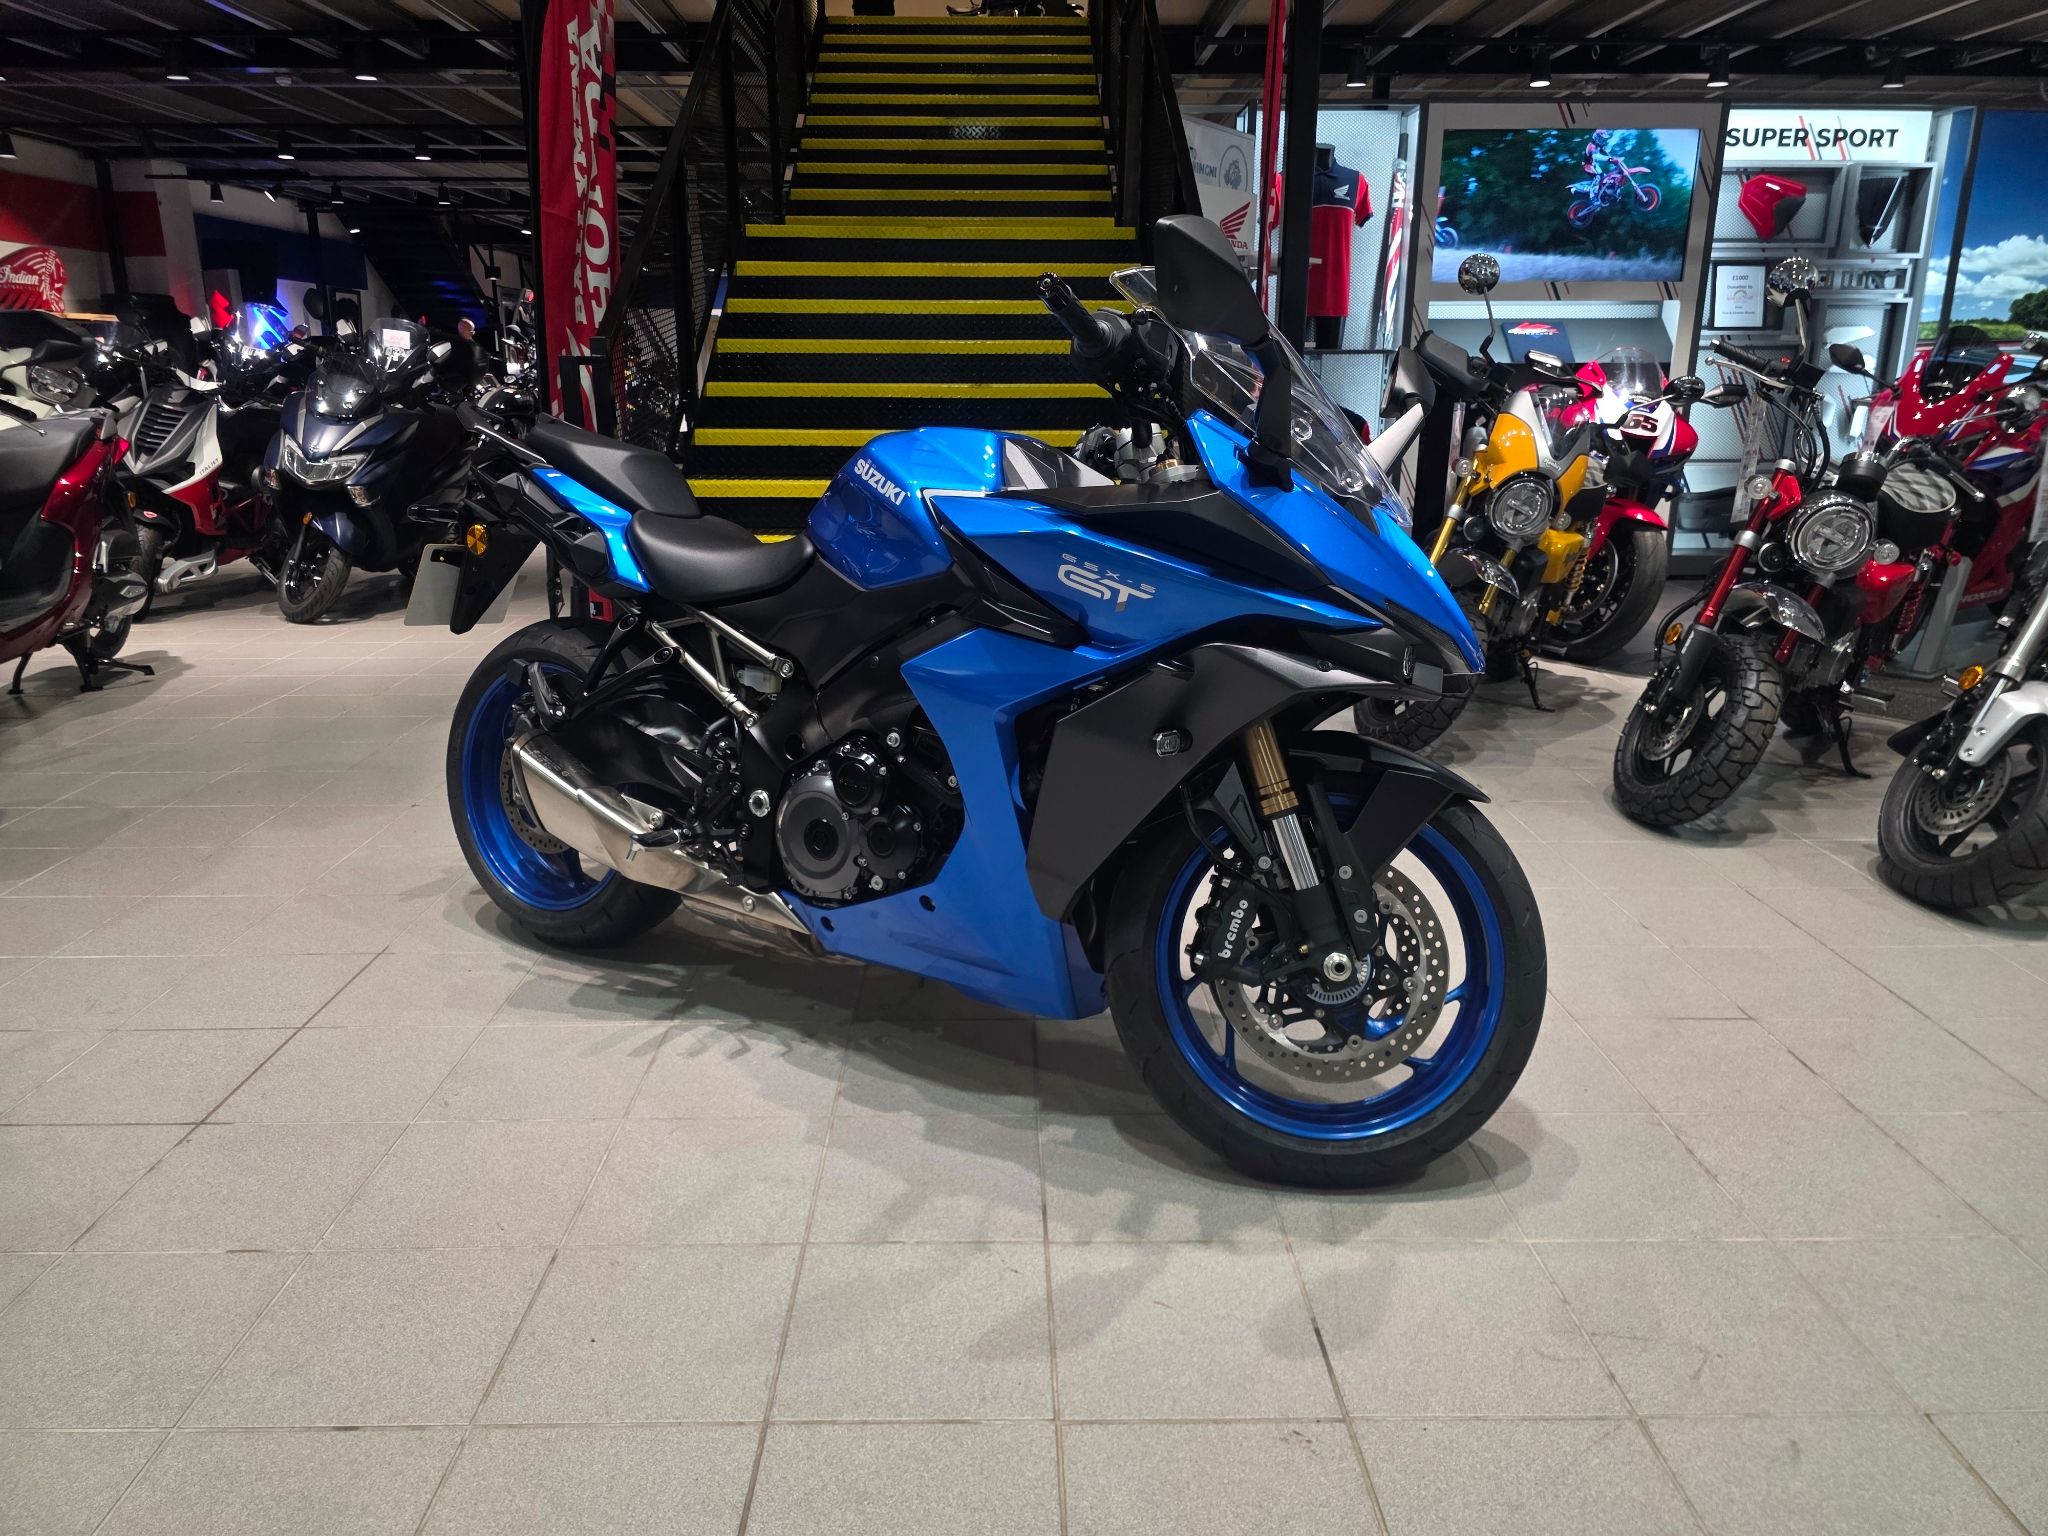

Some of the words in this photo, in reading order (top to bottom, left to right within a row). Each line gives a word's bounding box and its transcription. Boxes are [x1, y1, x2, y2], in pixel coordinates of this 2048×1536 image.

[1725, 127, 1809, 147] SUPER
[1816, 128, 1899, 148] SPORT
[0, 264, 40, 286] Indian
[854, 458, 906, 506] SUZUKI
[1218, 899, 1249, 959] brembo
